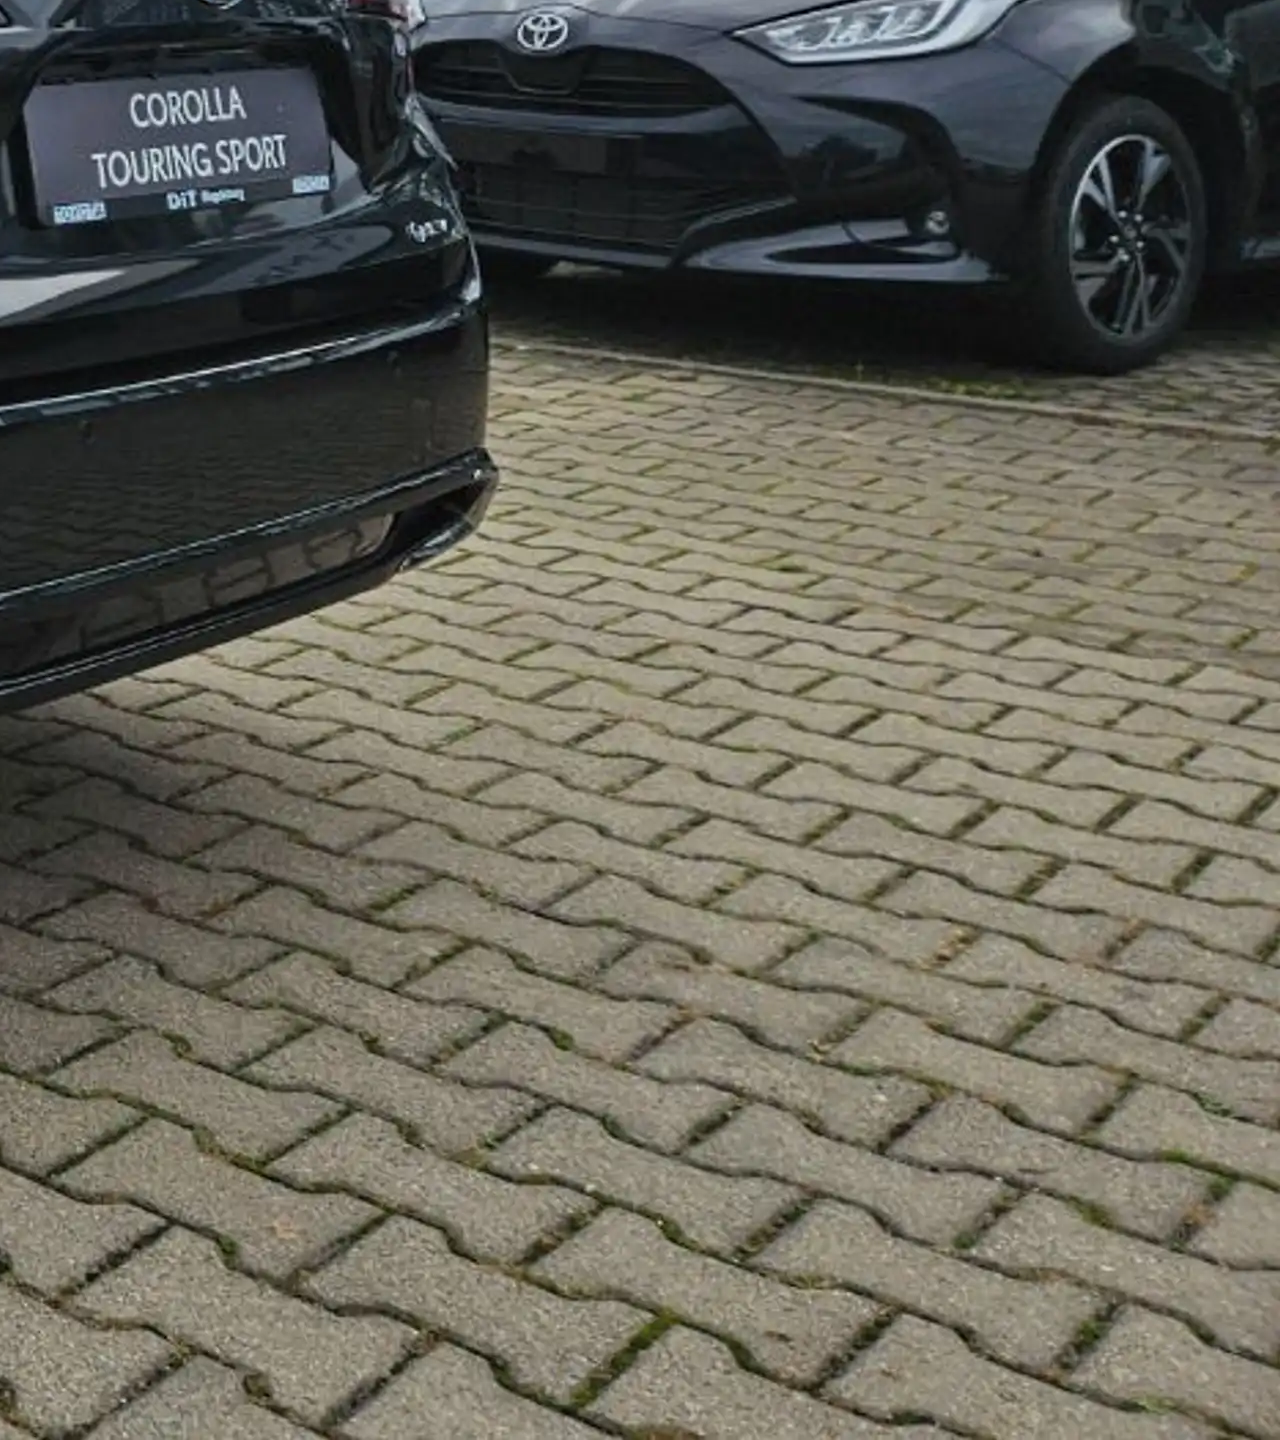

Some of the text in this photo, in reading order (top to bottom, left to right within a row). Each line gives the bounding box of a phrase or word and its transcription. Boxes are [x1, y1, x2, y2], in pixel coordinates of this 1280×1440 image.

[129, 85, 247, 128] COROLLA
[91, 133, 288, 189] TOURING SPORT
